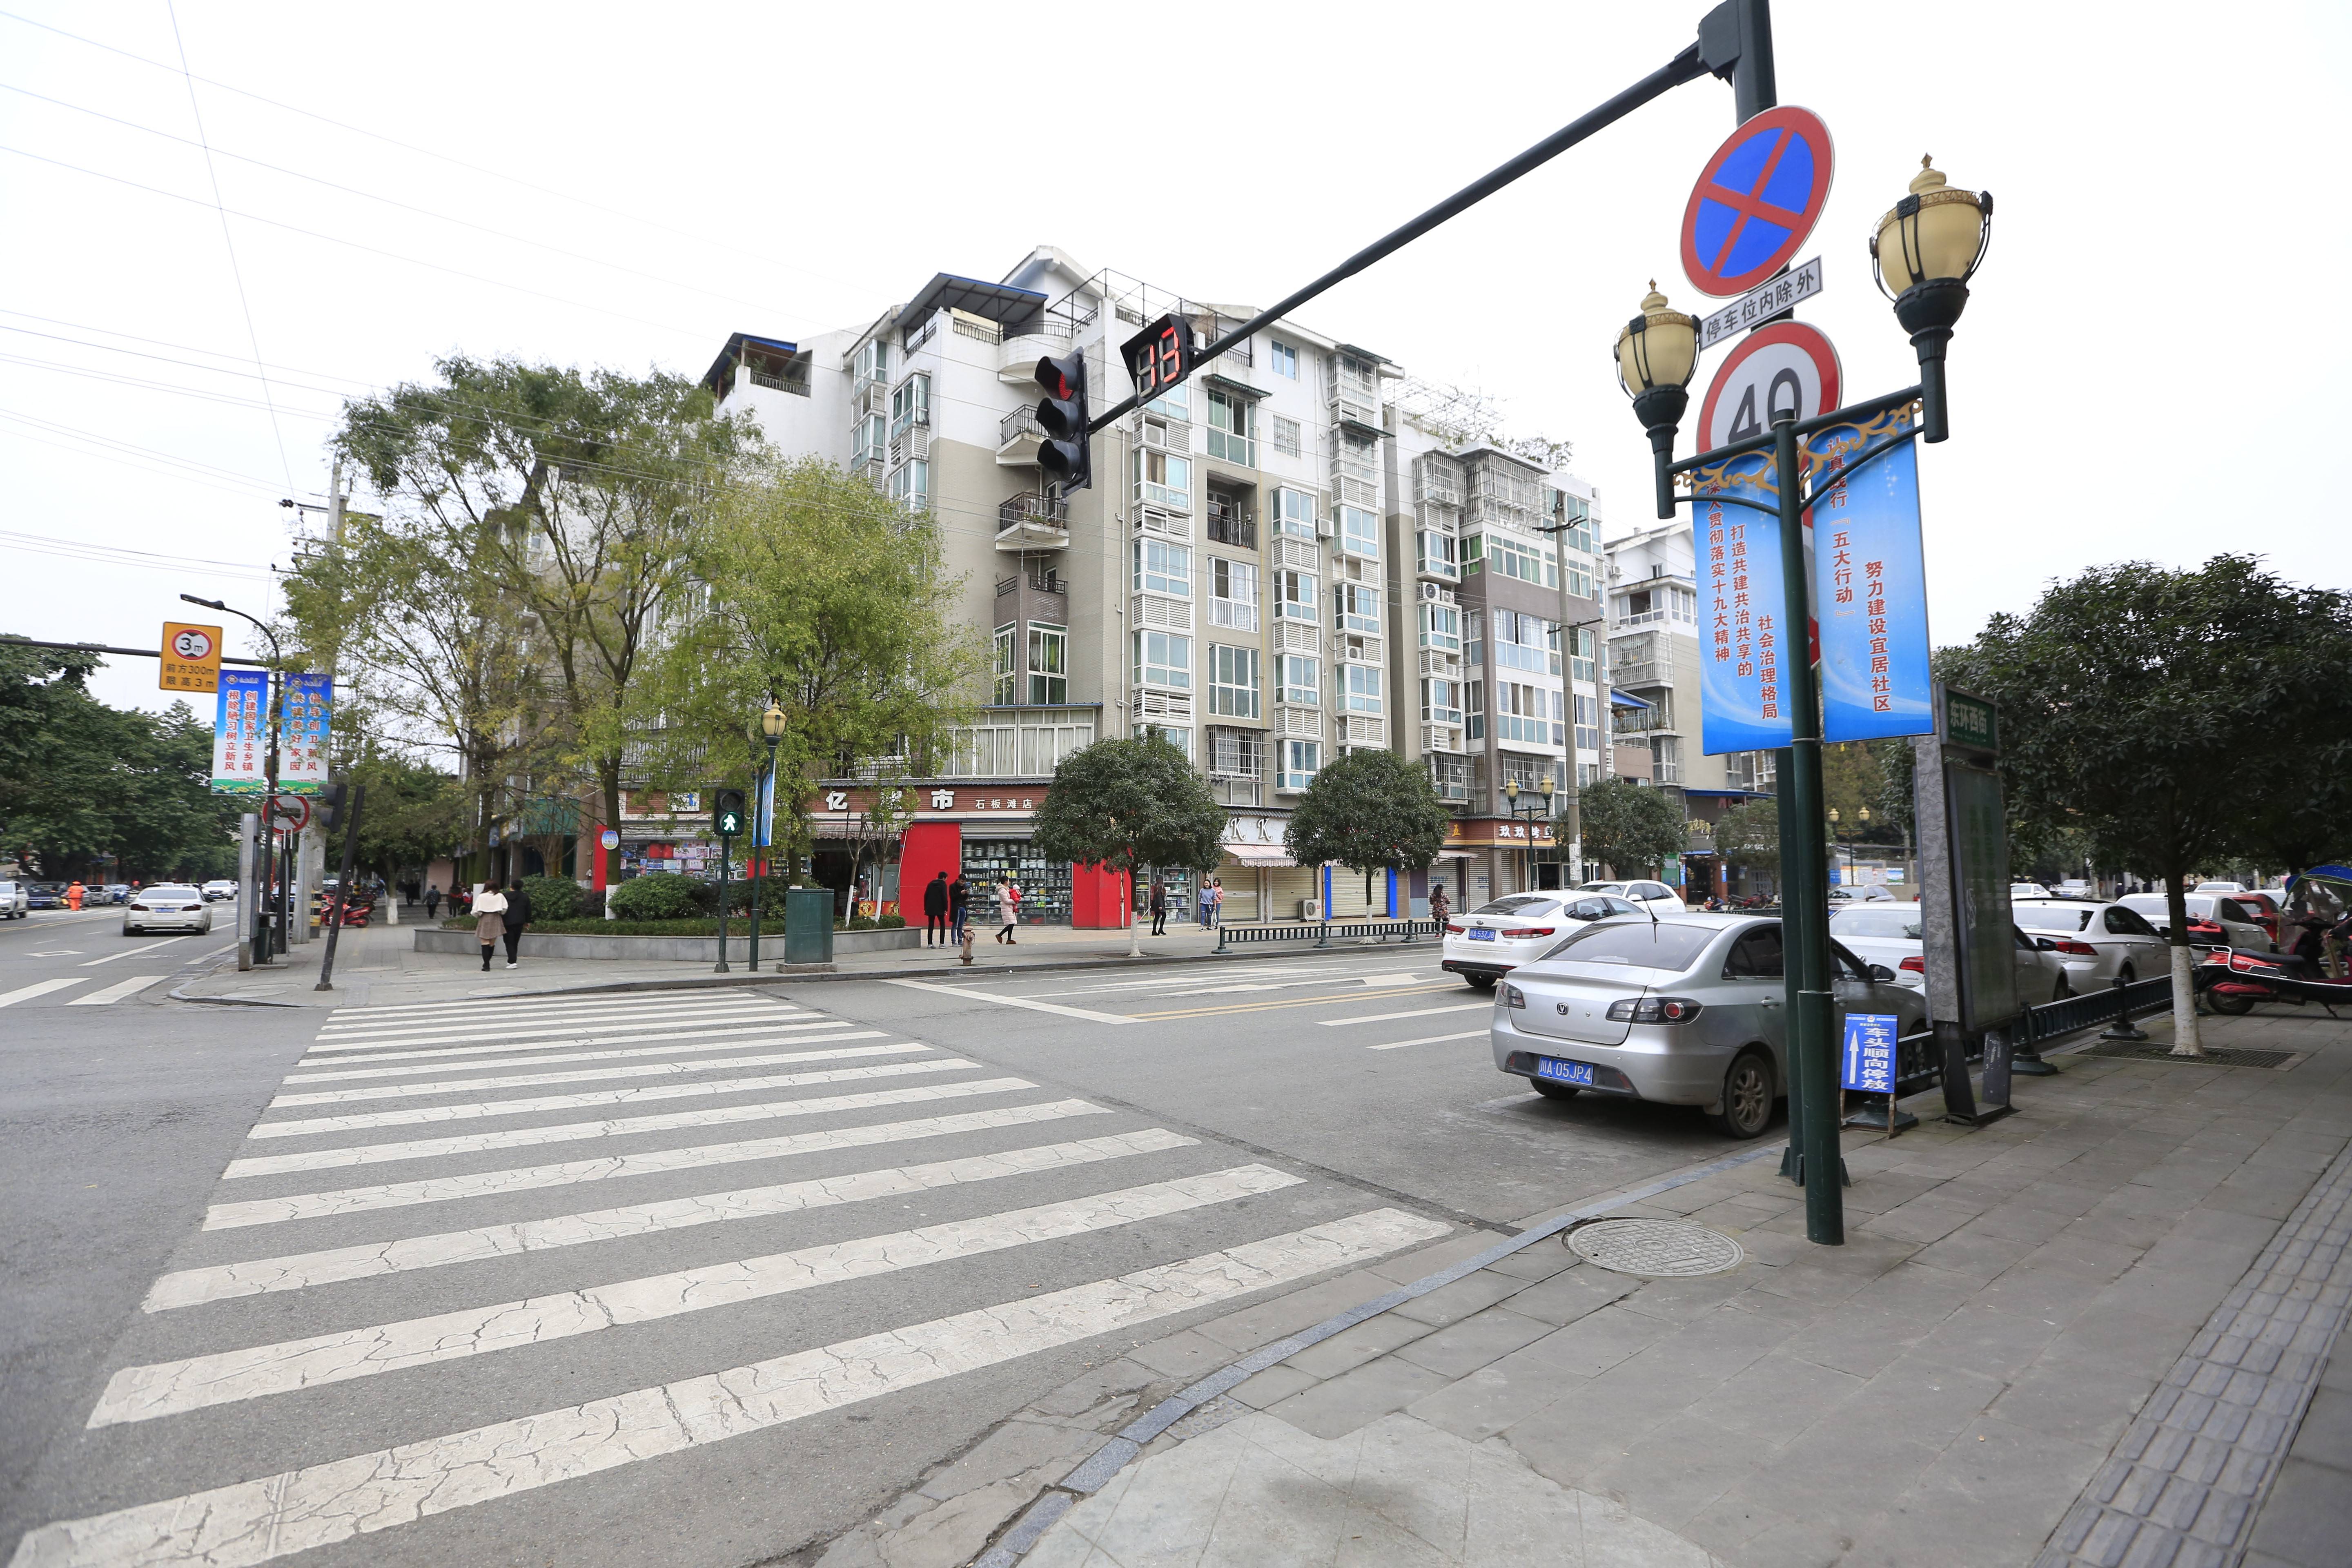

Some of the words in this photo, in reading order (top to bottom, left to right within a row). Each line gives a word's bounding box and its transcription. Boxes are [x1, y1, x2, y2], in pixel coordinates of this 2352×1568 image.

[1706, 268, 1814, 342] 停车位内除外
[1150, 326, 1181, 387] 13
[1728, 368, 1802, 445] 40
[1706, 478, 1731, 663] 深入贯彻落实十九大精神
[1730, 523, 1753, 677] 打造共建共治共享的
[166, 663, 215, 675] 前方300m
[180, 637, 203, 652] 3m
[1757, 614, 1778, 720] 社会治理格局
[1865, 560, 1892, 713] 努力建设宜居社区
[224, 690, 241, 771] 根除陋习树立新风
[242, 690, 258, 771] 创建国家卫生乡镇
[1950, 699, 1987, 735] 东环西街
[975, 798, 1032, 809] 石板滩店
[1861, 1027, 1890, 1090] 车头顺向停放
